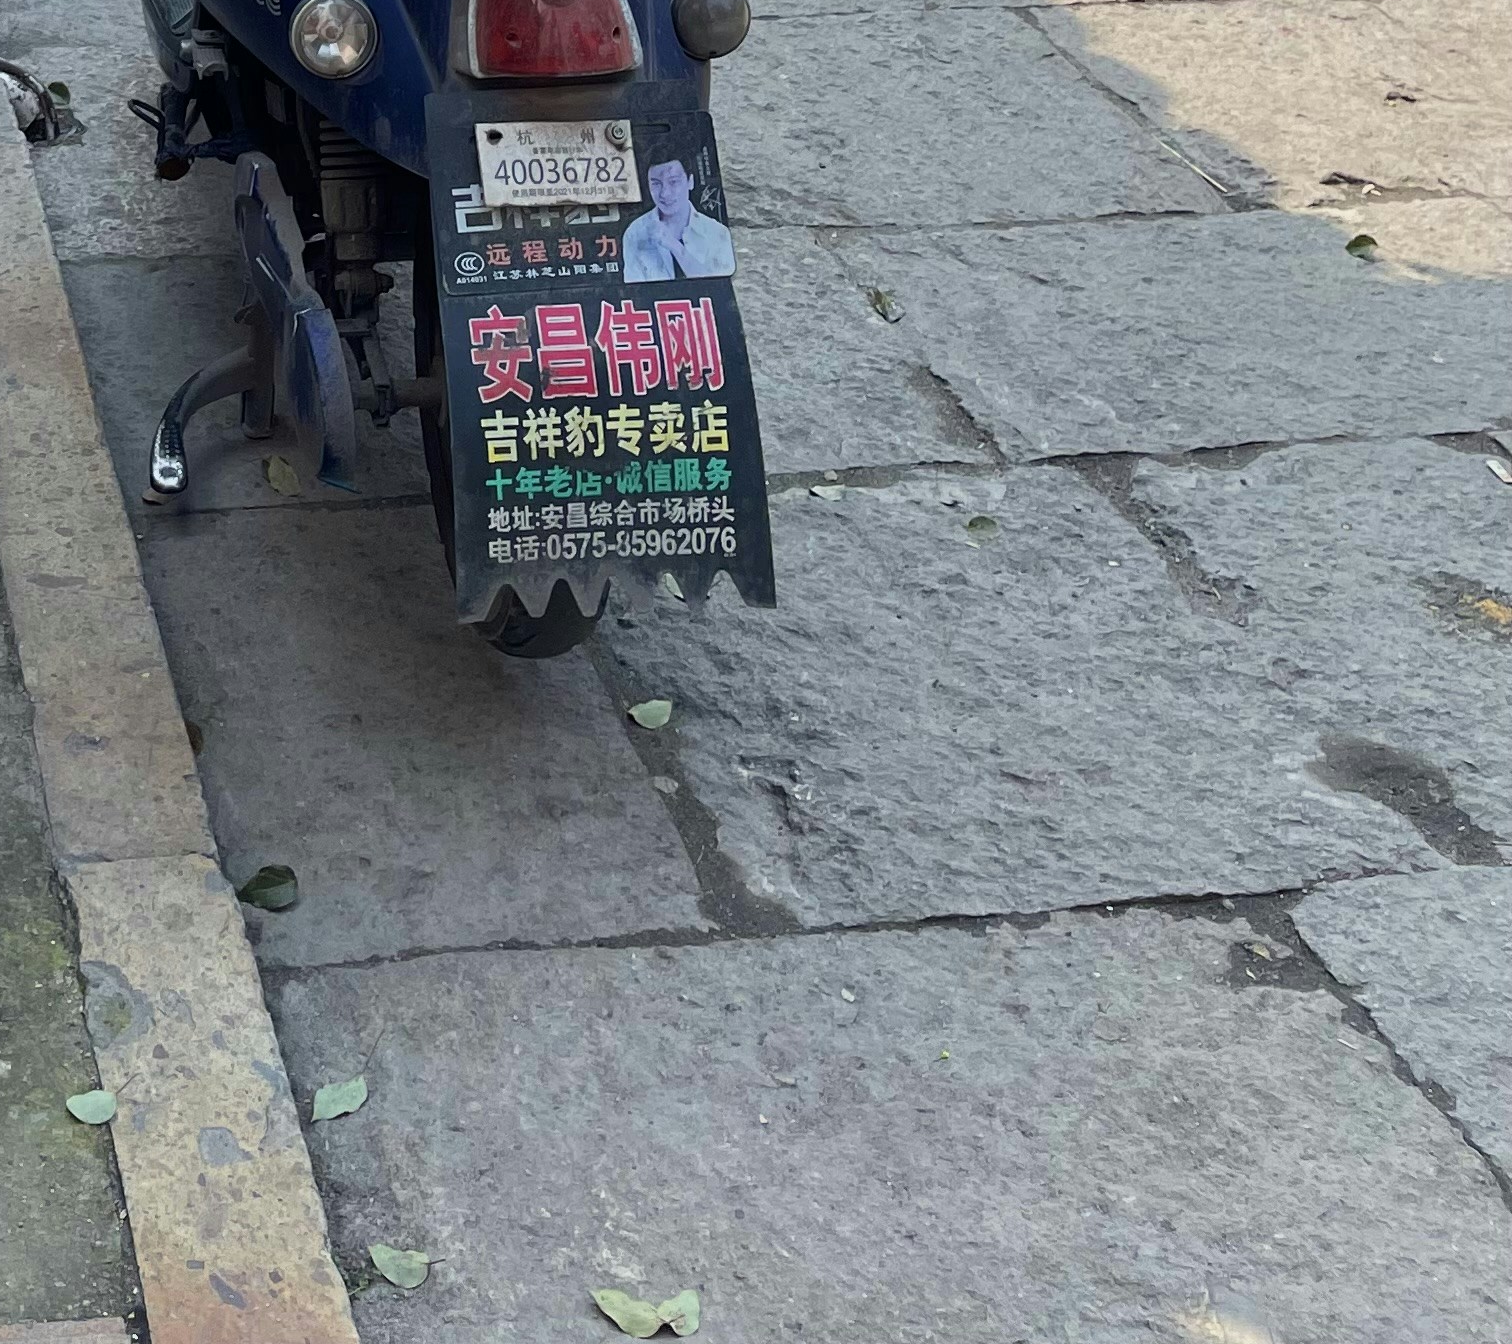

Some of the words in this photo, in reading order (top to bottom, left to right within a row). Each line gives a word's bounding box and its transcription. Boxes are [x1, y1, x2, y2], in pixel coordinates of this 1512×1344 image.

[517, 127, 596, 146] 杭州
[494, 156, 629, 186] 40036782
[486, 234, 619, 267] 远程动力
[492, 261, 620, 281] 江苏林芝山阳集团
[468, 297, 726, 404] 安昌伟刚
[480, 399, 730, 463] 吉祥豹专卖店
